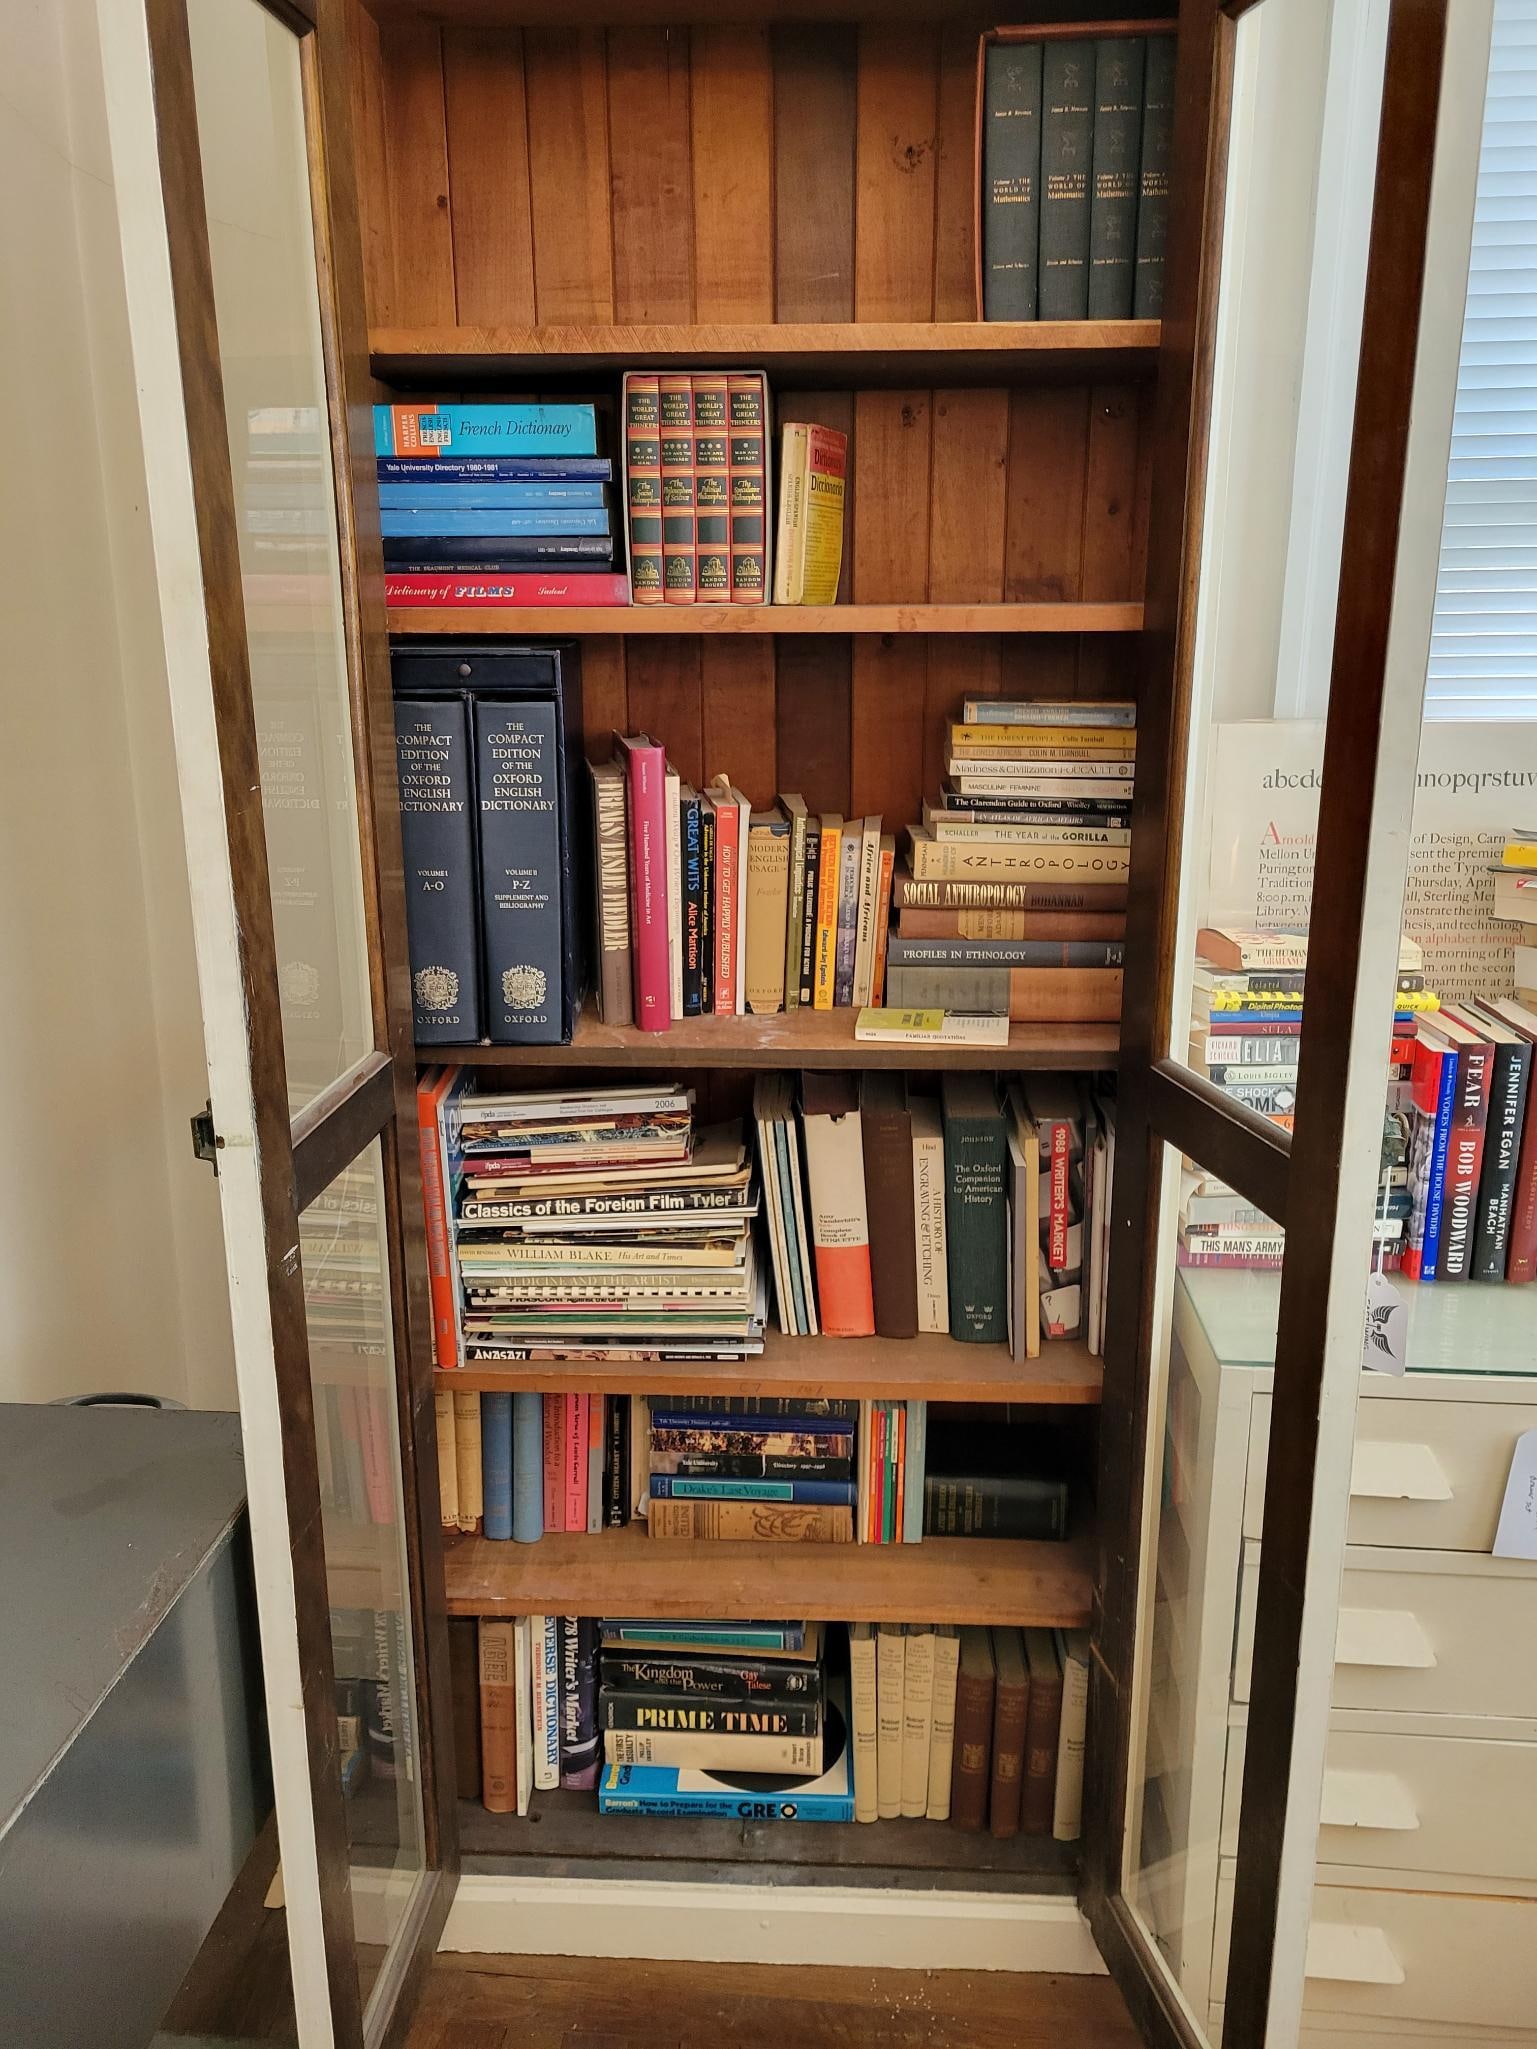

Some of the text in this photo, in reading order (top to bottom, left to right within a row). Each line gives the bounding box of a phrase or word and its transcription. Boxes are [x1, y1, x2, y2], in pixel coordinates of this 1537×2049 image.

[993, 195, 1031, 204] Mathematics
[1047, 190, 1085, 199] Mathematics
[662, 402, 689, 410] WORLD'S
[697, 402, 724, 410] WORLD'S
[732, 402, 759, 410] WORLD'S
[459, 420, 572, 437] French Dictionary
[661, 419, 691, 427] THINKERS
[401, 414, 409, 448] HARPER
[408, 413, 417, 448] COLLINS
[386, 463, 400, 472] Yale
[400, 463, 434, 473] University
[434, 463, 465, 472] Directory
[810, 474, 843, 497] Diccionario
[385, 584, 568, 599] Dictionary of FILMS Sadoul
[414, 723, 432, 732] THE
[506, 722, 525, 731] THE
[396, 735, 453, 746] COMPACT
[487, 734, 545, 745] COMPACT
[400, 749, 449, 760] EDITION
[492, 748, 541, 759] EDITION
[410, 763, 441, 771] OF THE
[501, 761, 533, 770] OF THE
[402, 775, 451, 785] OXFORD
[493, 774, 543, 784] OXFORD
[1417, 770, 1537, 794] nopqrstuv
[403, 788, 451, 799] ENGLISH
[494, 787, 542, 798] ENGLISH
[967, 784, 1006, 792] MASCULINE
[400, 801, 464, 812] ICTIONARY
[481, 800, 556, 811] DICTIONARY
[954, 798, 1091, 810] The Clarendon Guide to Oxford Woolley
[944, 829, 979, 837] SCHALLER
[994, 830, 1013, 840] THE
[1015, 831, 1039, 841] YEAR
[1061, 832, 1109, 844] GORILLA
[686, 808, 700, 892] GREAT WITS
[749, 844, 789, 853] MODERN
[749, 854, 789, 863] ENGLISH
[865, 840, 875, 875] Africa
[749, 865, 779, 873] USAGE
[963, 856, 1131, 871] ANTHROPOLOGY
[423, 881, 445, 891] A-O
[512, 880, 532, 890] P-Z
[1257, 877, 1312, 888] Tradition
[1466, 876, 1496, 890] April
[903, 882, 940, 905] SOCIAL
[944, 883, 1026, 907] ANTHROPOLOGY
[862, 898, 872, 943] Africans
[688, 901, 699, 970] Alice Mattison
[1424, 932, 1527, 947] alphabet through
[903, 950, 1027, 960] PROFILES IN ETHNOLOGY
[1435, 947, 1501, 961] morning of
[1396, 1002, 1420, 1010] QUICK
[416, 1015, 461, 1025] OXFORD
[503, 1014, 548, 1024] OXFORD
[1261, 1025, 1293, 1034] SULA
[1244, 1039, 1283, 1063] ELIA
[1463, 1054, 1485, 1109] FEAR
[1236, 1087, 1277, 1098] SHOCK
[654, 1099, 676, 1110] 2006
[1498, 1055, 1522, 1170] JENNIFER EGAN
[954, 1164, 1002, 1173] The Oxford
[955, 1175, 1001, 1185] Companion
[964, 1185, 1003, 1194] American
[1052, 1127, 1066, 1263] 1988 WRITER'S MARKET
[964, 1194, 994, 1205] History
[464, 1193, 732, 1219] Classics of the Foreign Film Tyler
[1447, 1140, 1476, 1274] BOB WOODWARD
[1485, 1198, 1500, 1235] BEACH
[1494, 1183, 1511, 1250] MANHATTAN
[1200, 1240, 1284, 1253] THIS MAN'S ARMY
[506, 1248, 684, 1261] WILLIAM BLAKE His Art and Times
[501, 1276, 565, 1286] MEDICINE
[567, 1275, 598, 1286] AND
[602, 1275, 630, 1286] THE
[631, 1275, 680, 1286] ARTIST
[473, 1347, 527, 1361] ANASAZI
[682, 1483, 779, 1499] Drake's Last Voyage
[621, 1662, 694, 1681] The Kingdom
[740, 1670, 759, 1682] Gay
[544, 1614, 558, 1767] EVERSE DICTIONARY
[564, 1639, 579, 1743] Writer's Market
[636, 1707, 788, 1733] PRIME TIME
[624, 1733, 634, 1764] CASUALTY
[605, 1798, 733, 1810] Barron's How to Prepare for the
[605, 1806, 728, 1818] Graduate Record Examination
[736, 1801, 778, 1819] GRE
